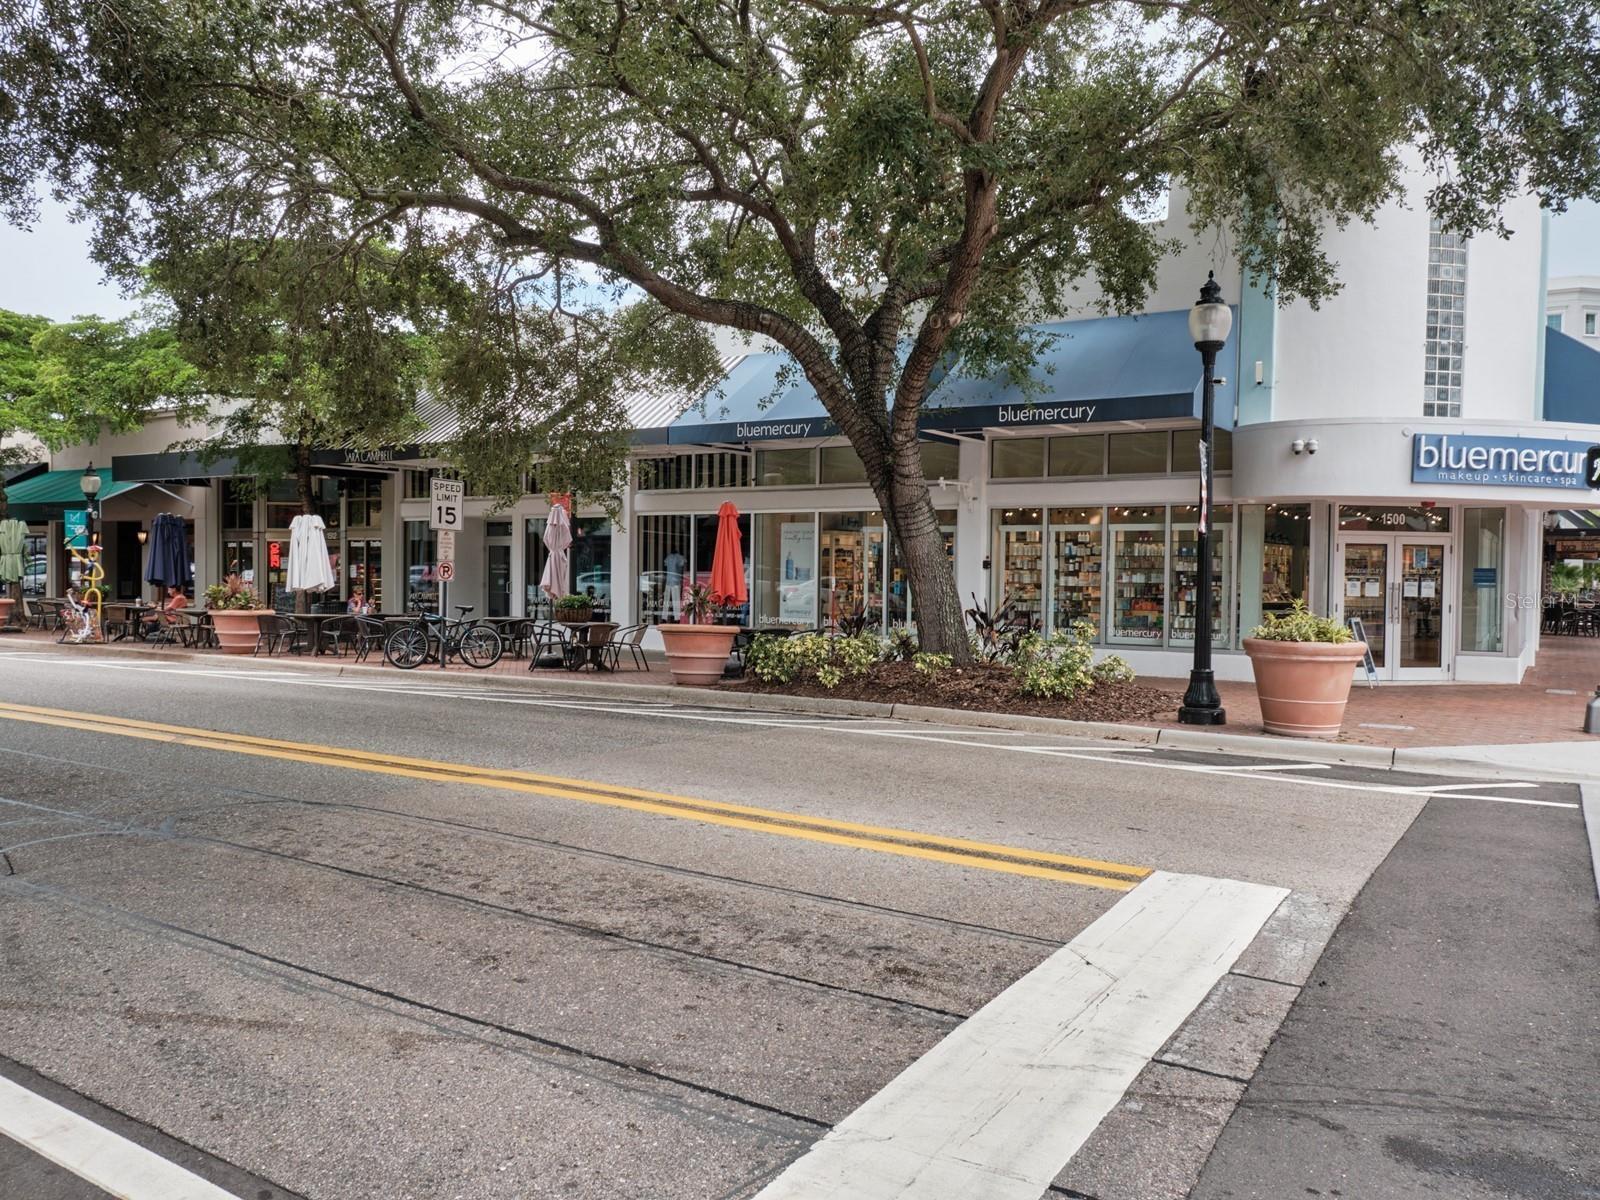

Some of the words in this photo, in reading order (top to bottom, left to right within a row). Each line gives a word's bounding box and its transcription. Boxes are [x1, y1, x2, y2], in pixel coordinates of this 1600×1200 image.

[998, 405, 1096, 422] bluemercury
[736, 423, 811, 437] bluemercury
[1419, 435, 1587, 474] bluemercur
[1438, 471, 1489, 484] makeup
[1502, 472, 1552, 484] skincare
[1560, 476, 1577, 486] spa
[433, 482, 461, 493] SPEED
[436, 493, 458, 503] LIMIT
[437, 505, 456, 525] 15
[1381, 512, 1406, 525] 1500
[270, 543, 280, 568] OPEN
